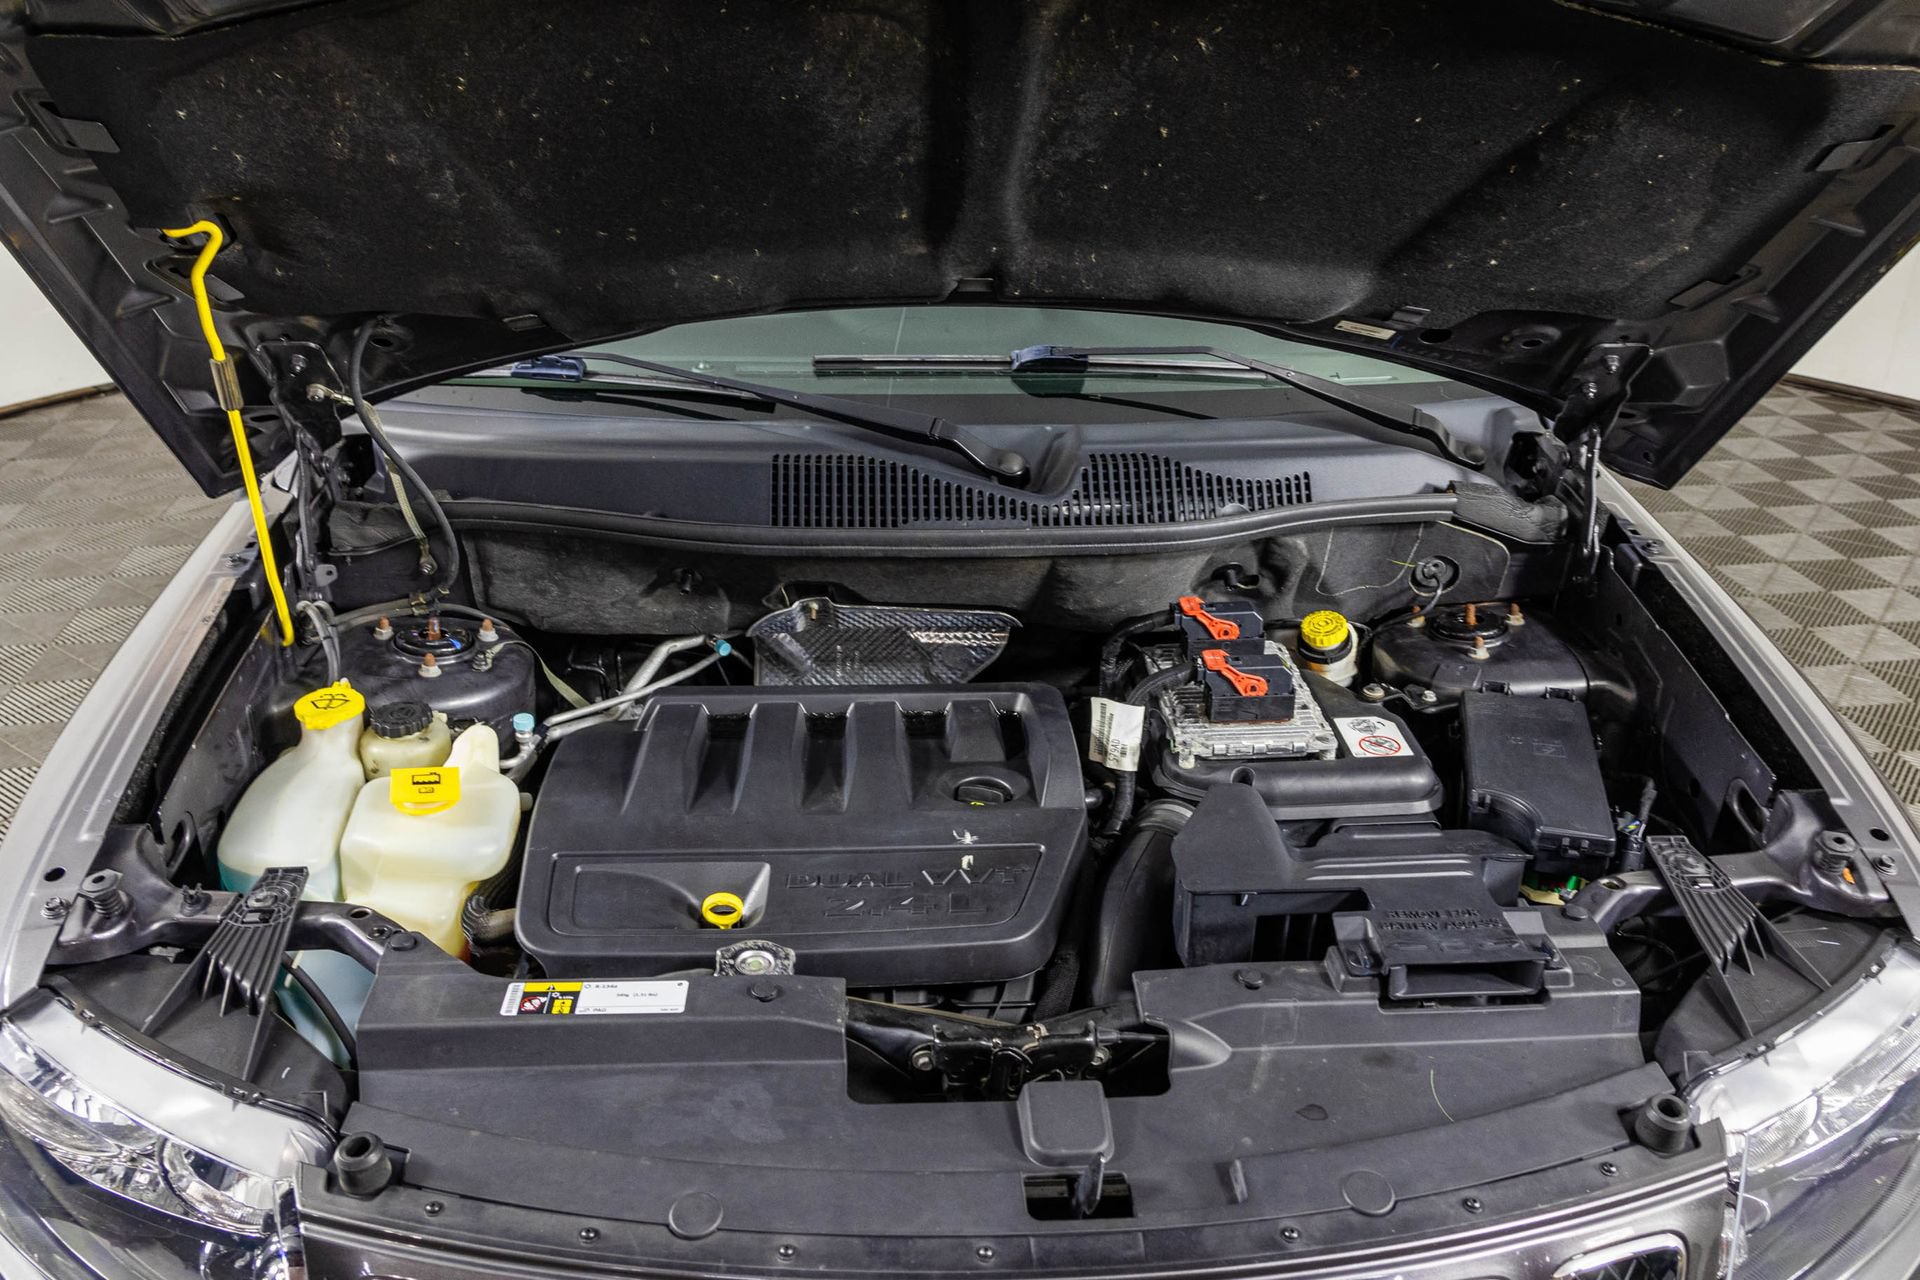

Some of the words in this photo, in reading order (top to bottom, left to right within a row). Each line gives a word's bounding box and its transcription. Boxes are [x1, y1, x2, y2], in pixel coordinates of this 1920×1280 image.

[786, 871, 915, 888] DUAL
[921, 867, 1030, 886] VVT
[824, 892, 990, 918] 2.4L
[1379, 919, 1439, 931] BATTERY
[1445, 917, 1503, 930] ACCESS
